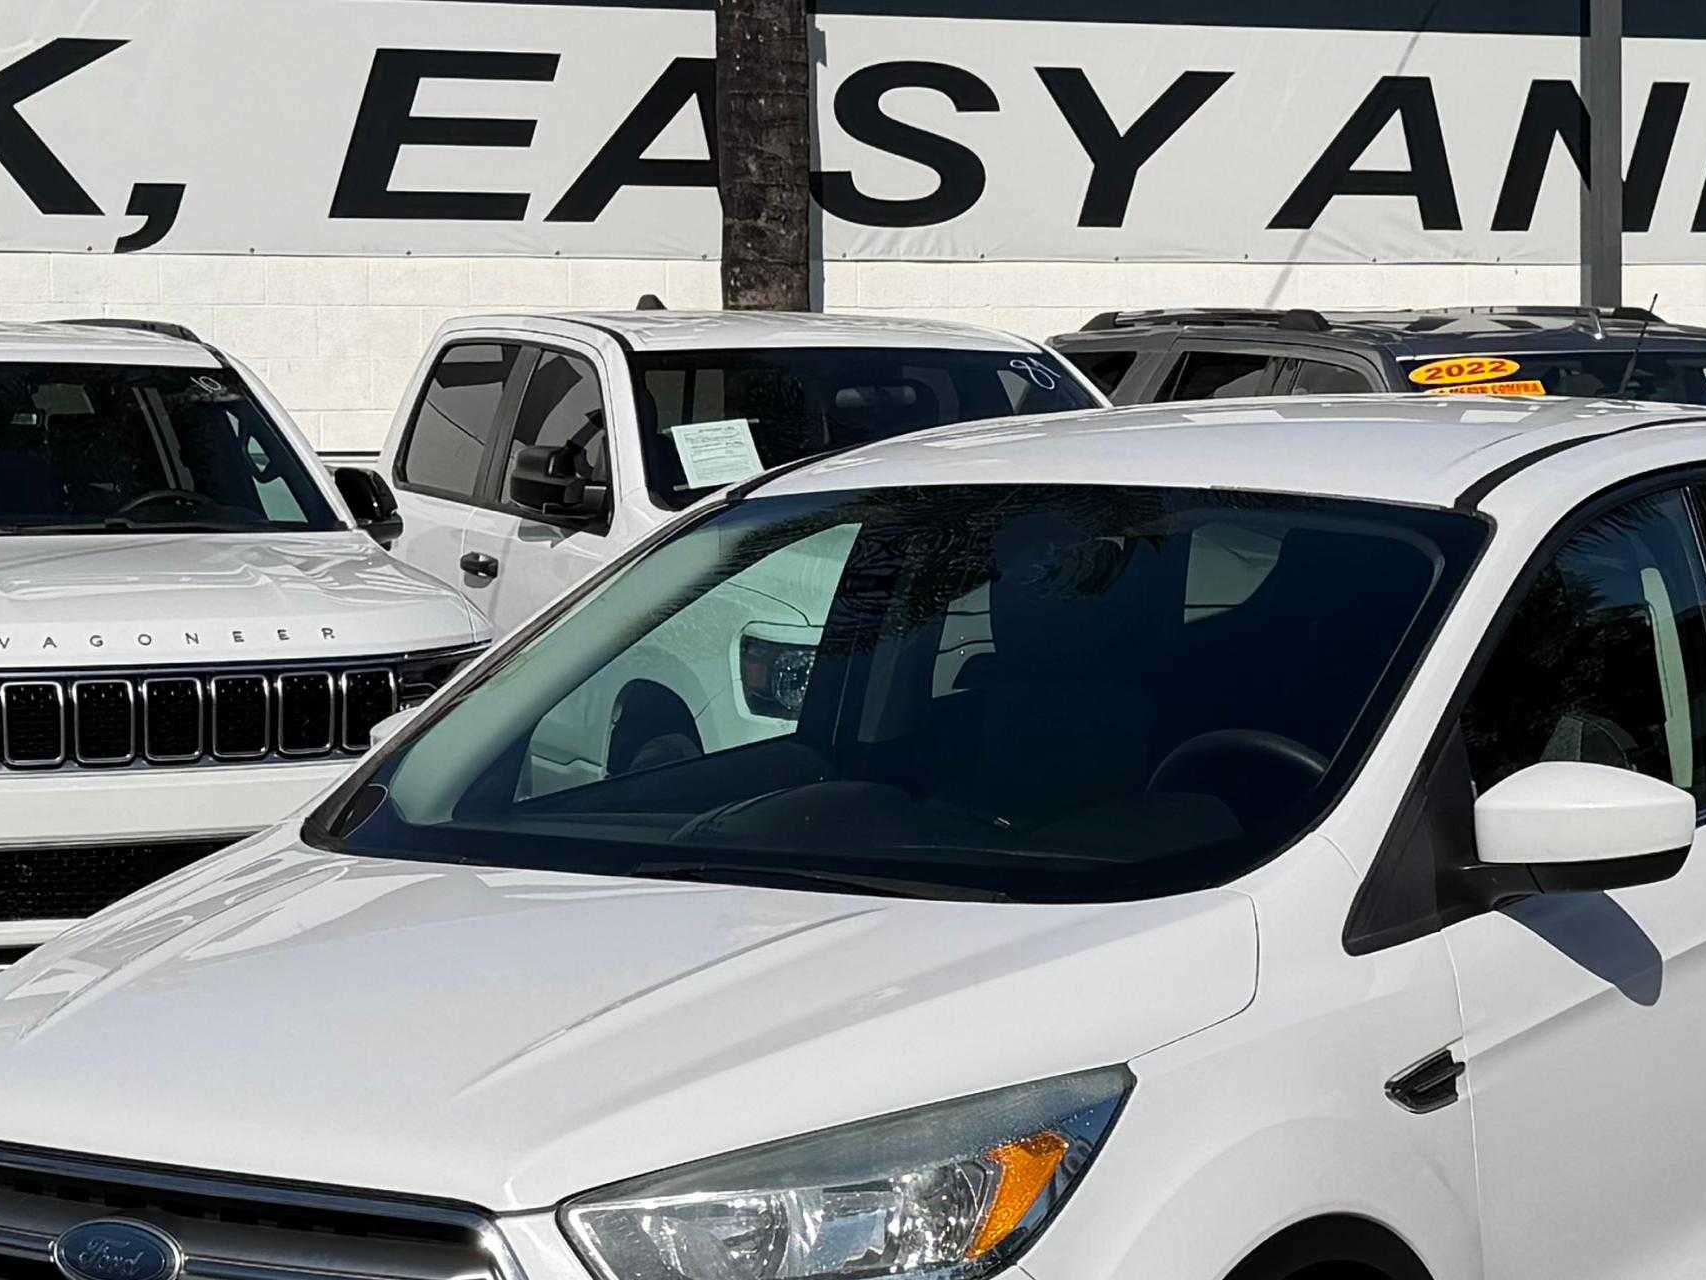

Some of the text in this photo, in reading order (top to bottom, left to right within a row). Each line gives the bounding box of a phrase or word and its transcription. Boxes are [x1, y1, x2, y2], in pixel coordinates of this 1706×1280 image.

[329, 48, 1235, 231] EASY
[1424, 360, 1508, 381] 2022
[78, 1239, 144, 1277] Ford
